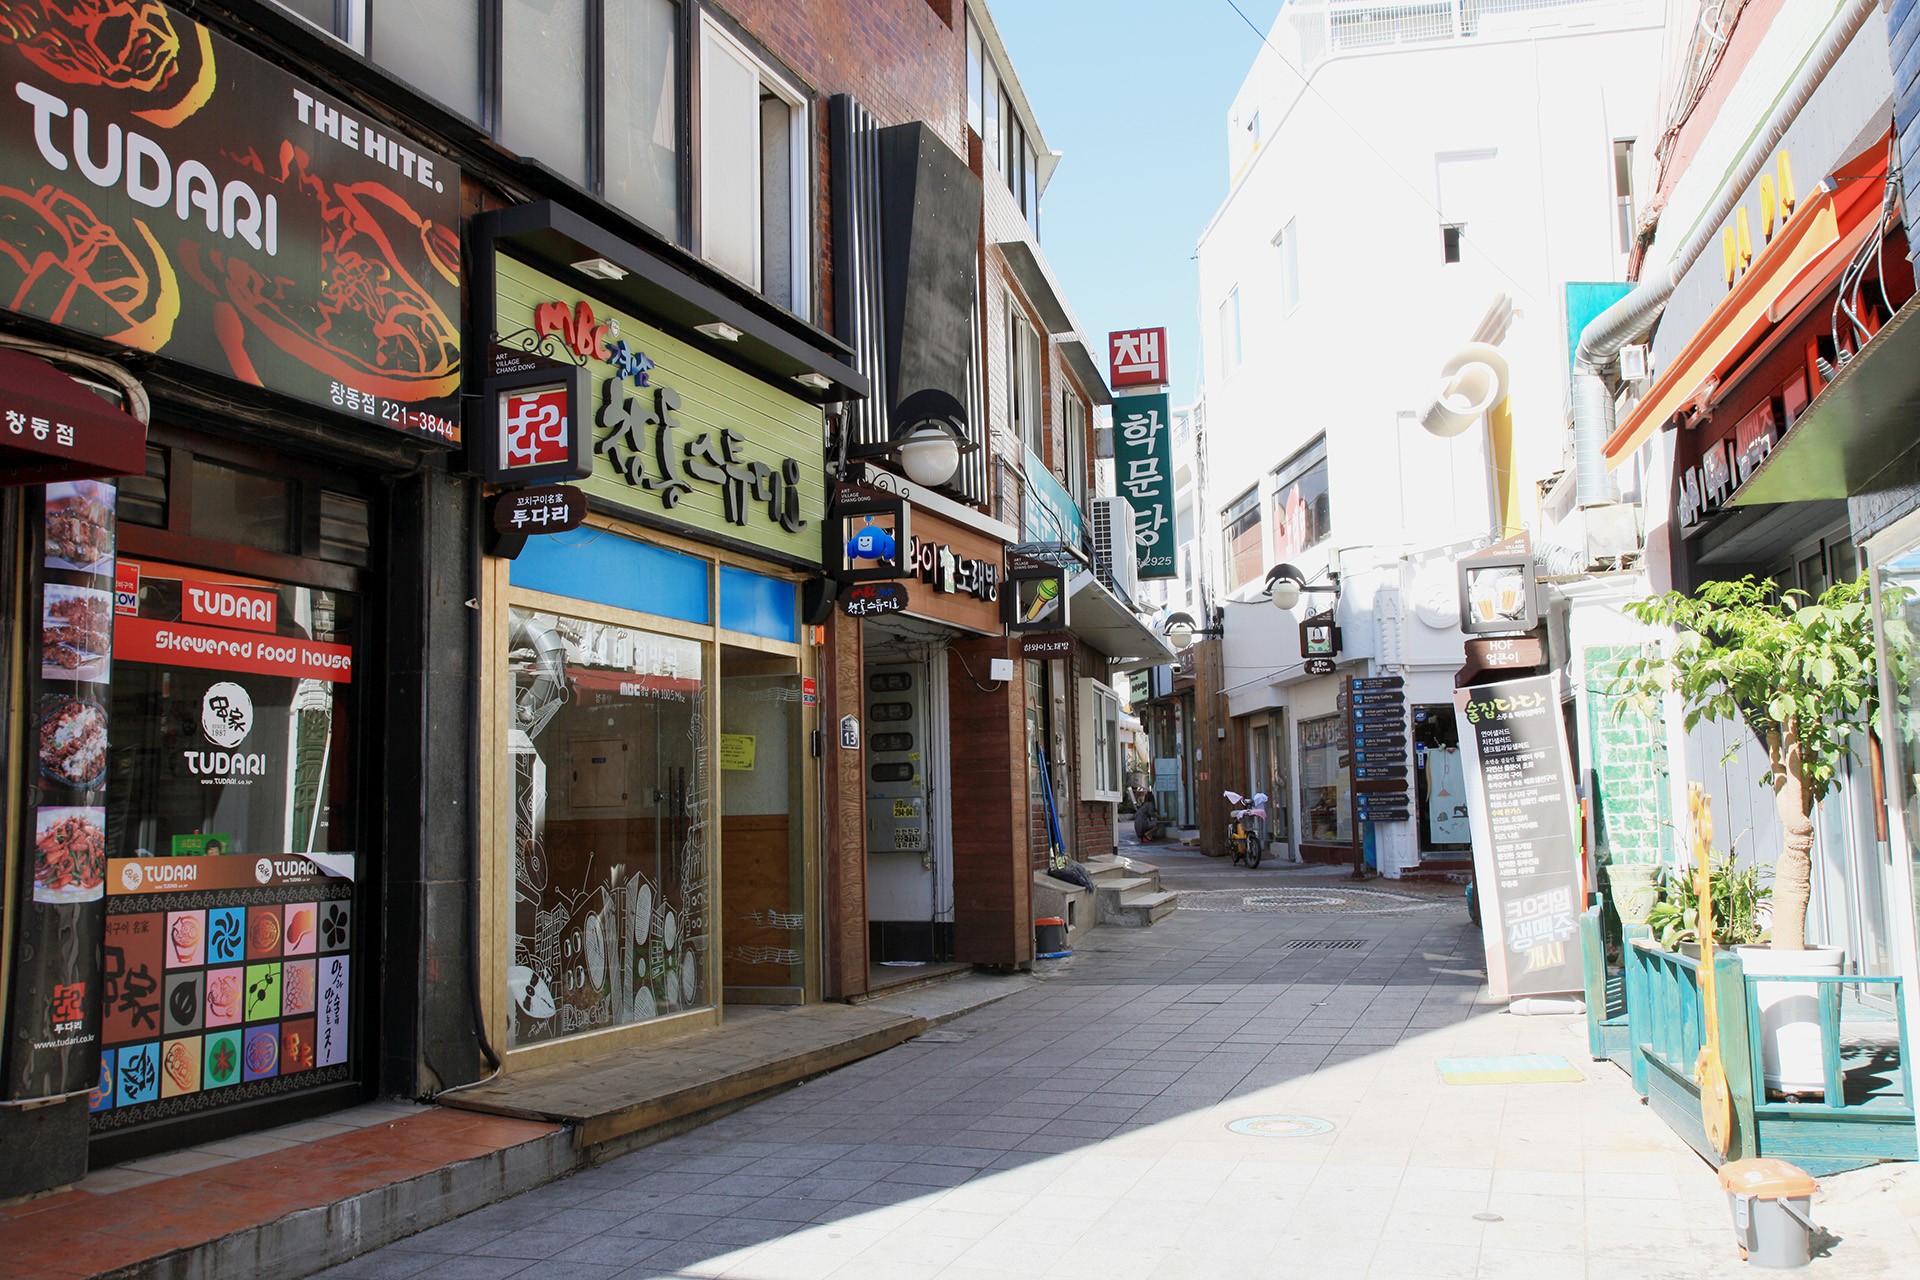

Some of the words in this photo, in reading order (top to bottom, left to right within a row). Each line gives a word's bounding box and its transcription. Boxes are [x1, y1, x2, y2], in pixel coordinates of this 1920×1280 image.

[293, 88, 359, 151] THE
[364, 133, 444, 194] HITE.
[15, 81, 278, 257] TUDARI
[496, 358, 520, 367] VILLAGE
[1113, 331, 1160, 380] 책
[496, 366, 517, 374] CHANG
[517, 363, 536, 372] DONG
[330, 382, 376, 415] 창동점
[382, 400, 454, 438] 221-3844
[5, 409, 75, 447] 창동점
[1120, 409, 1169, 547] 학문당
[510, 504, 570, 529] 투다리
[956, 554, 999, 603] 노래방
[189, 588, 272, 622] TUDARI
[155, 630, 252, 660] Skewered
[256, 642, 297, 664] food
[301, 645, 352, 670] house
[1024, 642, 1069, 651] 하와이노래방
[1489, 640, 1514, 651] HOF
[1486, 651, 1519, 666] 얼큰이
[211, 729, 226, 737] 1987
[844, 732, 856, 745] 13
[184, 751, 266, 775] TUDARI
[144, 864, 197, 883] TUDARI
[106, 921, 130, 936] 치구이
[133, 920, 149, 934] 名家
[1511, 911, 1573, 950] 생맥주
[1527, 941, 1563, 970] 개시
[54, 1020, 82, 1034] 투다리
[34, 1034, 95, 1049] www.tudari.co.kr
